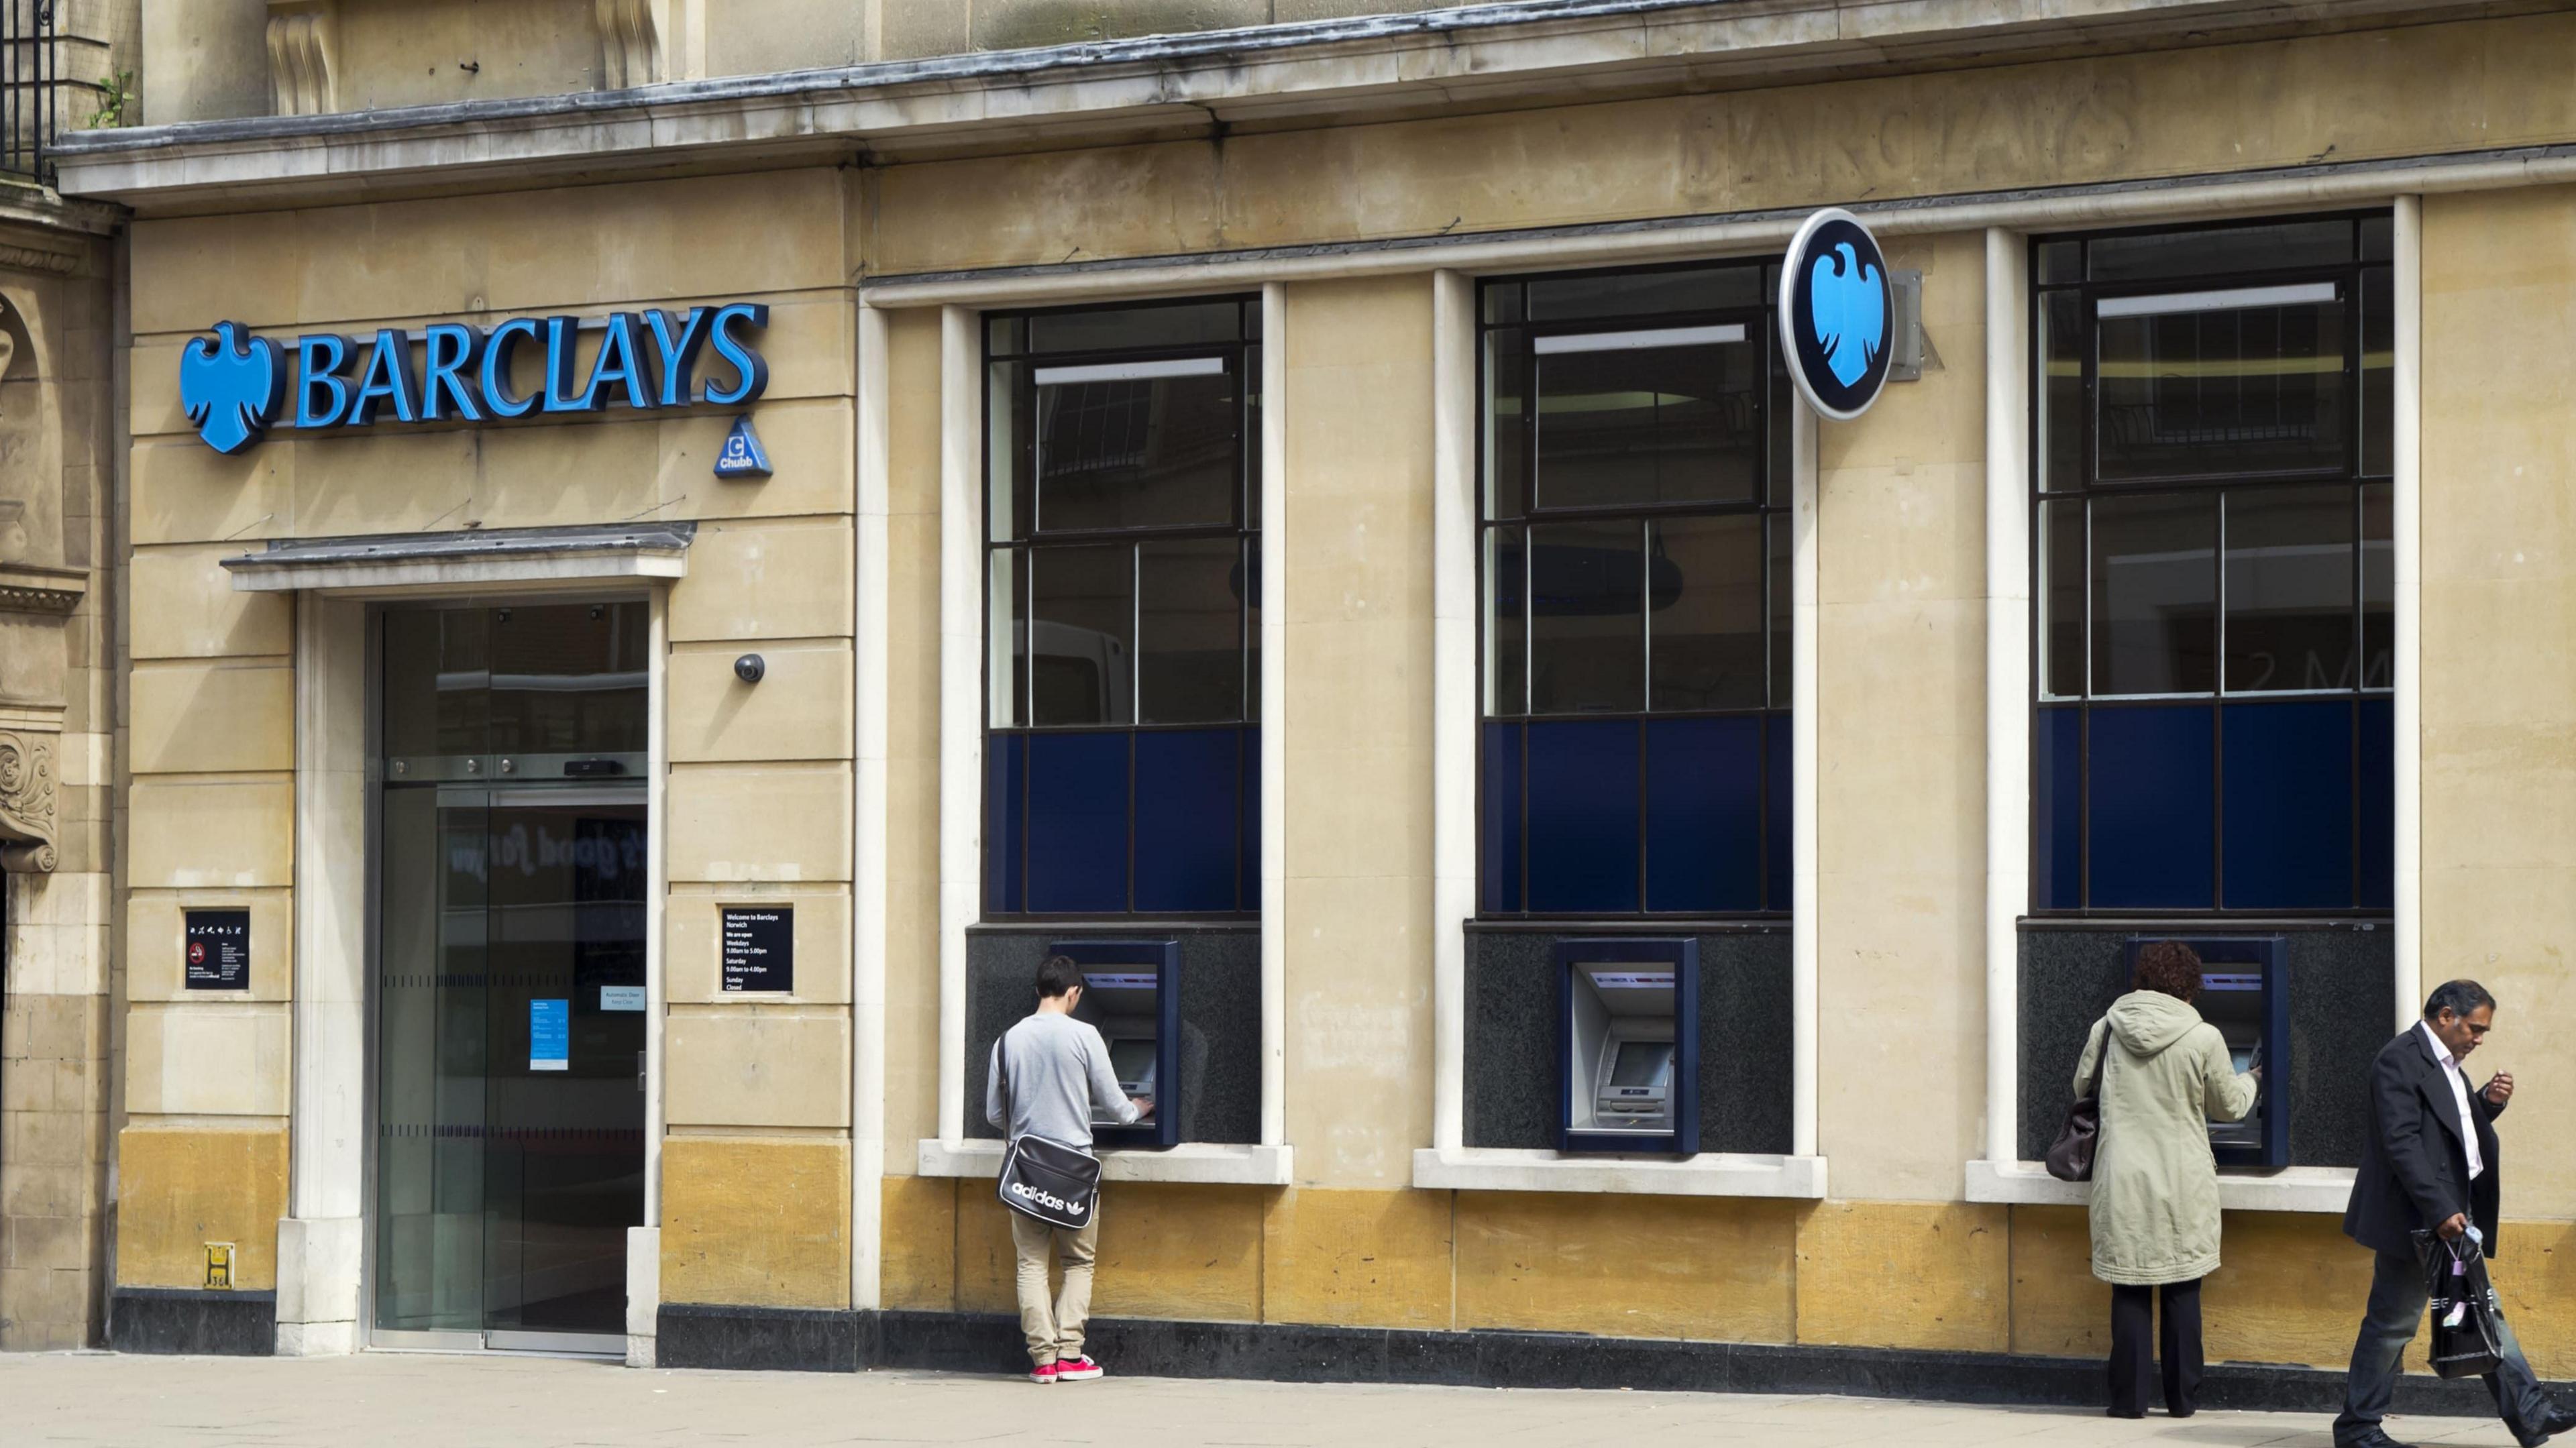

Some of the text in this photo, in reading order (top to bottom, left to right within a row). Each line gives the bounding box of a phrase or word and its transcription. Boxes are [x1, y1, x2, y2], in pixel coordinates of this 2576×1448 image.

[295, 303, 769, 429] BARCLAYS
[720, 456, 753, 469] Chubb
[1012, 1182, 1065, 1211] adidas
[207, 1248, 229, 1285] H
